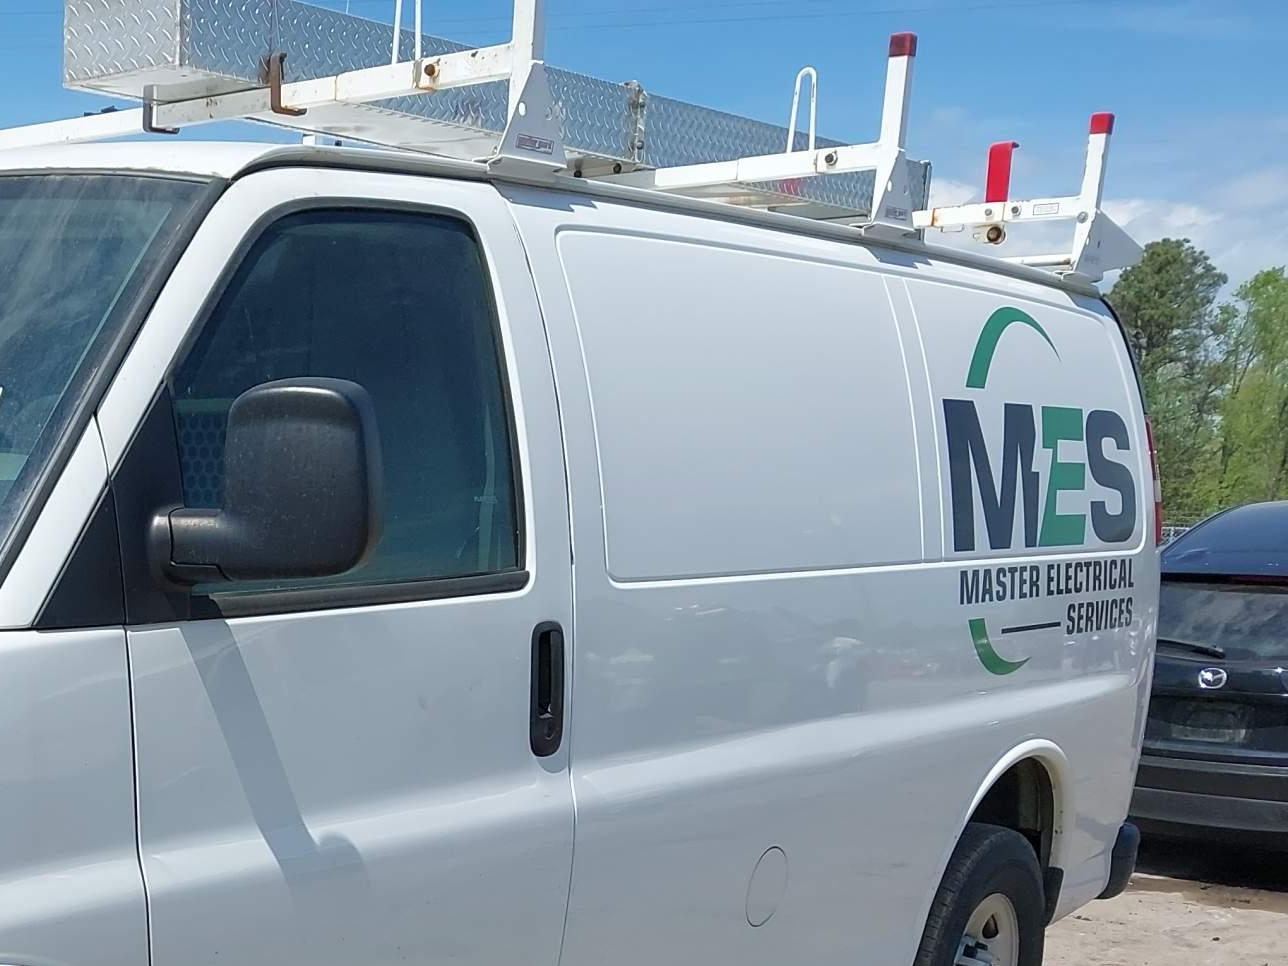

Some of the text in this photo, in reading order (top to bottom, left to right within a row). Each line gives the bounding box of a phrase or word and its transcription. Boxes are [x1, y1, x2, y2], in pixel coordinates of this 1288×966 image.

[942, 398, 1137, 552] MES
[959, 558, 1134, 606] MASTER ELECTRICAL
[1066, 597, 1133, 635] SERVICES
